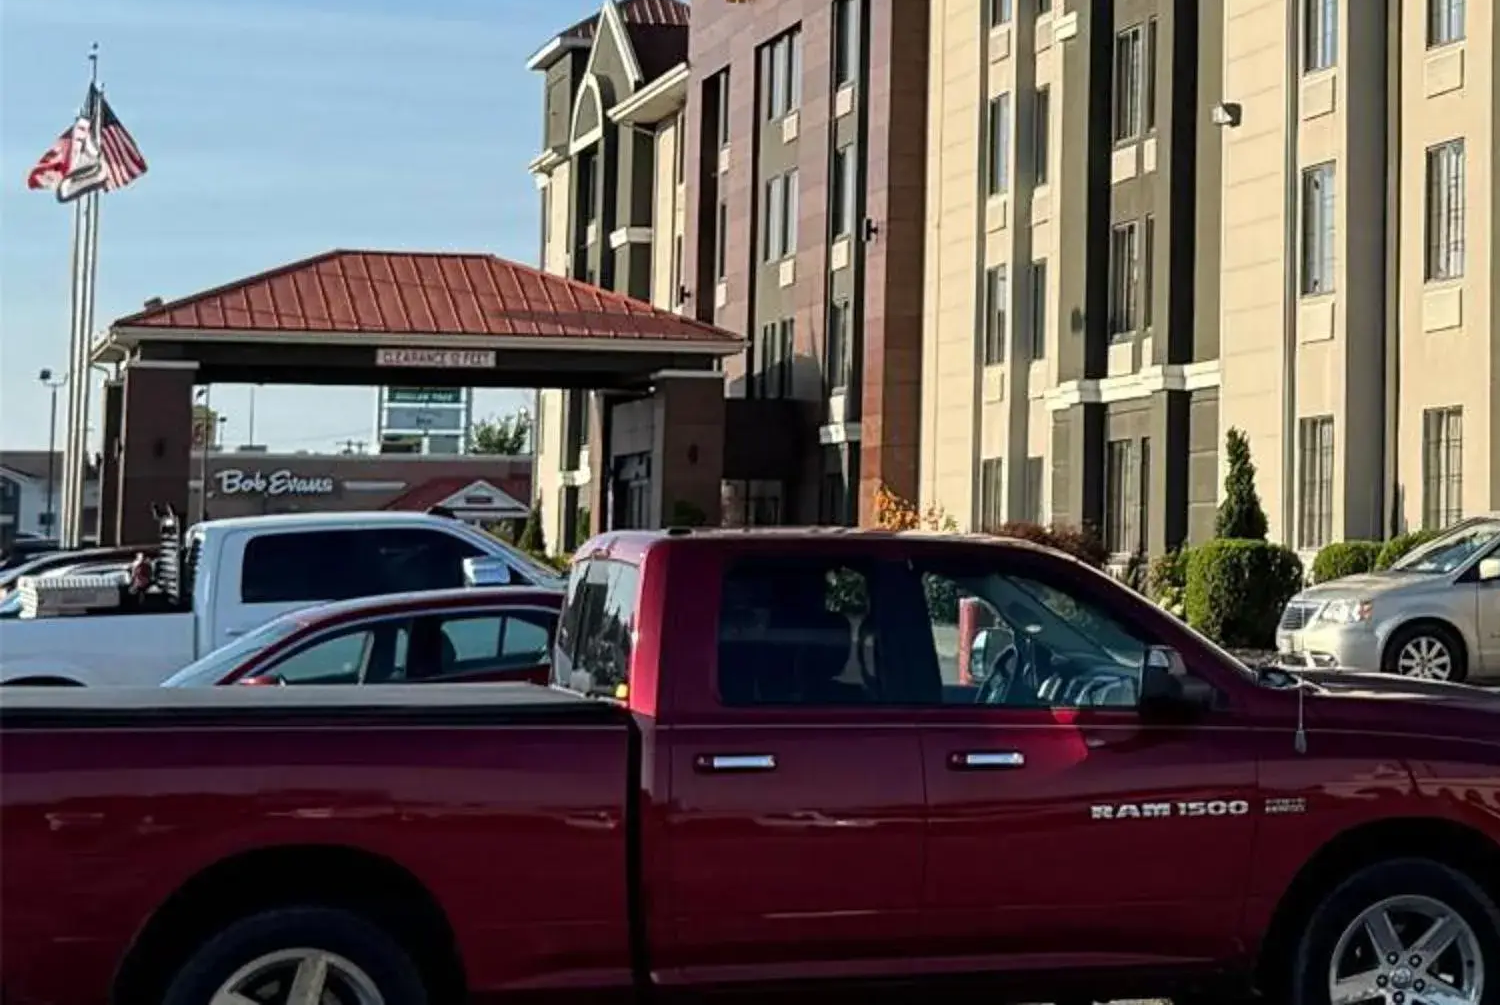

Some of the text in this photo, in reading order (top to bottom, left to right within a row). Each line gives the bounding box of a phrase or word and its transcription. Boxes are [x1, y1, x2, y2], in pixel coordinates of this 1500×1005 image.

[215, 469, 334, 495] Bob Evans
[1091, 803, 1171, 820] RAM
[1177, 799, 1249, 816] 1500
